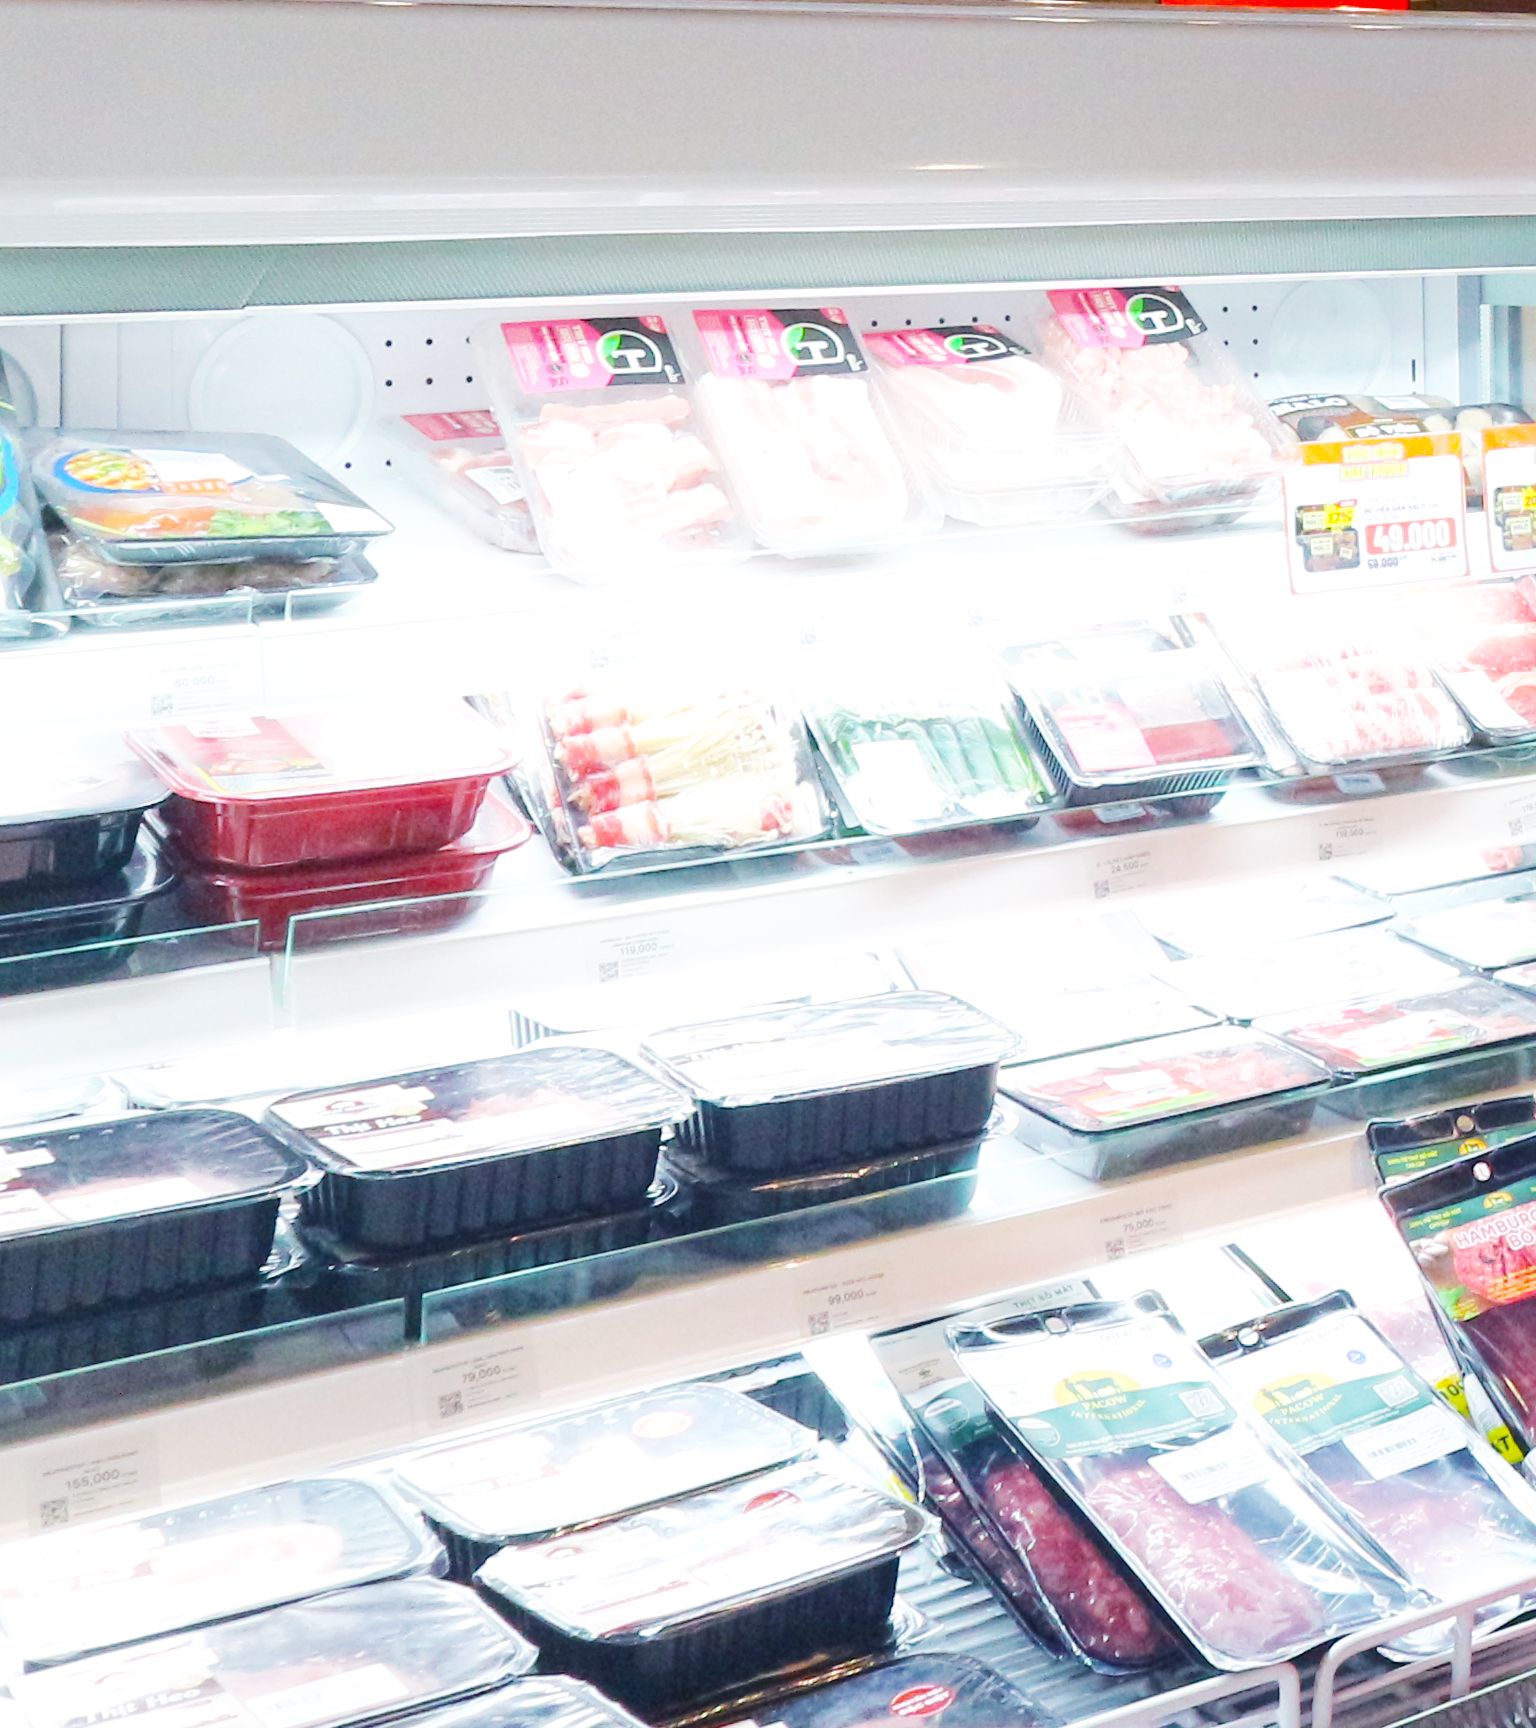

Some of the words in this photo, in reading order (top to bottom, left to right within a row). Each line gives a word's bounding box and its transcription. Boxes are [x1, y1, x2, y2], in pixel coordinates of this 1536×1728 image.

[1374, 519, 1451, 553] 49.000
[1082, 1392, 1128, 1410] PACOW
[1279, 1391, 1325, 1416] PACOW
[65, 1468, 121, 1490] 155,000
